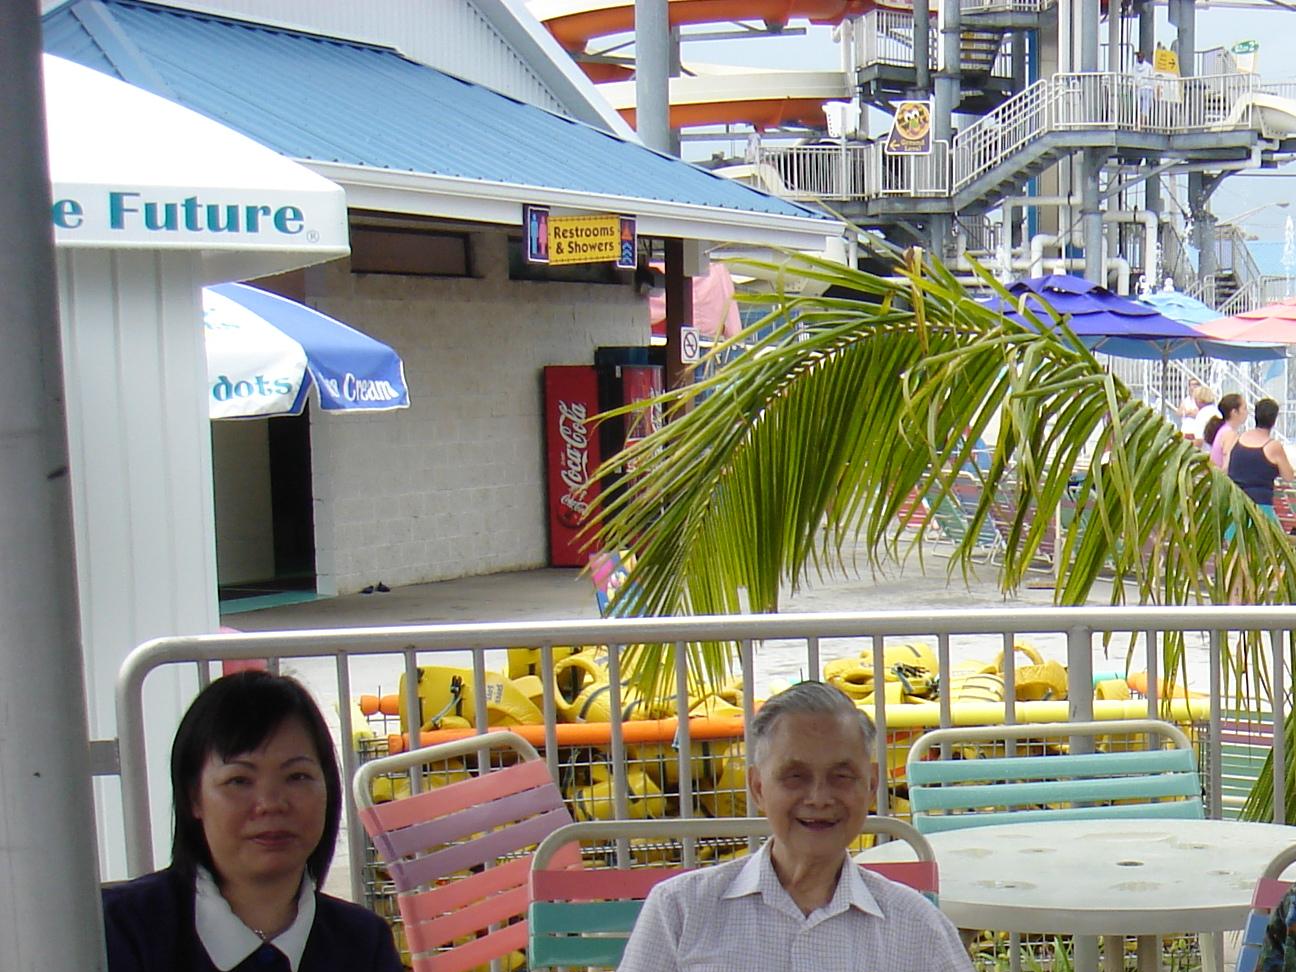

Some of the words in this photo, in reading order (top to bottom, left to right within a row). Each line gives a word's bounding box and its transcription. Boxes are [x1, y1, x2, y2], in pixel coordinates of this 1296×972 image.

[109, 191, 305, 235] Future
[553, 225, 616, 240] Restrooms
[556, 242, 564, 255] &
[567, 241, 615, 255] Showers
[212, 375, 293, 402] dots
[343, 372, 400, 402] Cream
